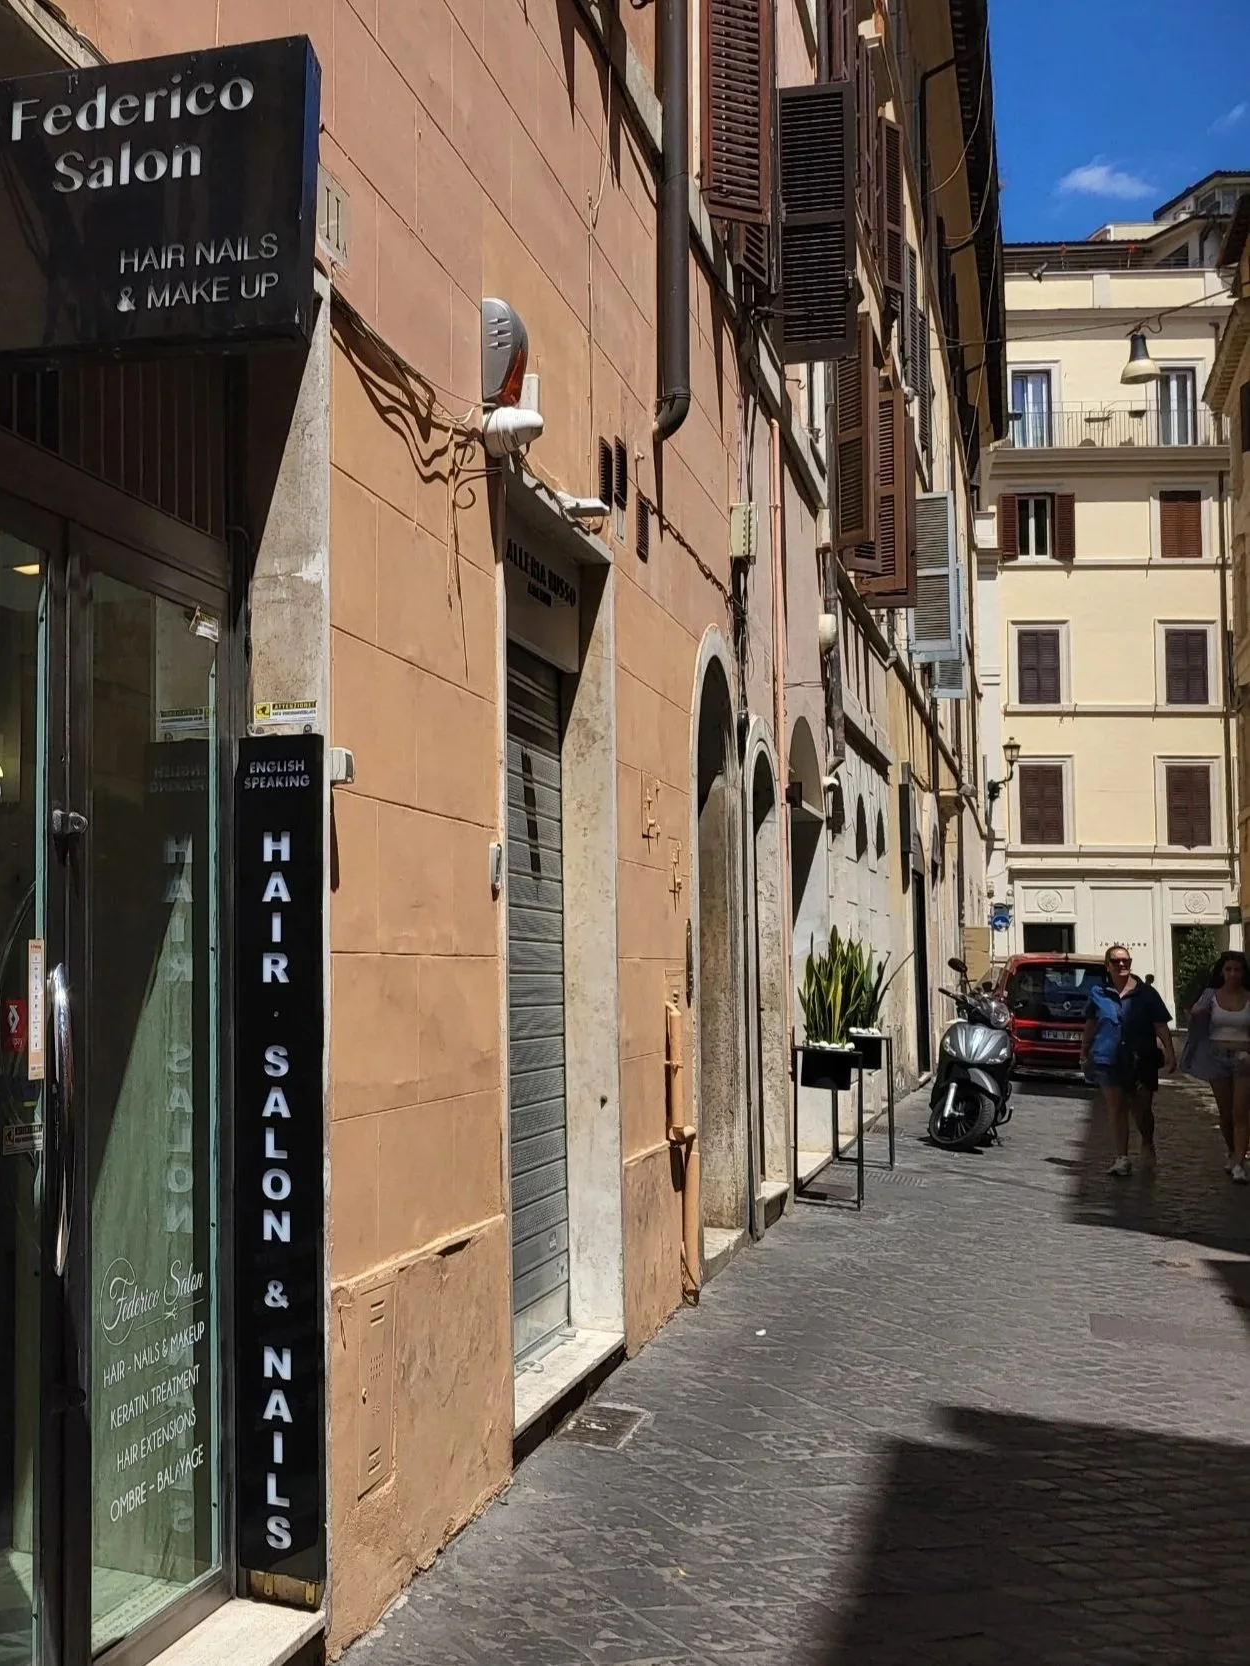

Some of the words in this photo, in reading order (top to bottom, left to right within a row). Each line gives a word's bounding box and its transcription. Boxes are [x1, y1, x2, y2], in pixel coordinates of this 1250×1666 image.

[11, 73, 255, 141] Federico
[52, 141, 203, 193] Salon
[119, 243, 185, 275] HAIR
[195, 232, 279, 263] NAILS
[116, 286, 136, 312] &
[147, 276, 230, 309] MAKE
[240, 273, 279, 300] UP
[506, 538, 547, 587] ALLERIA
[244, 775, 310, 789] SPEAKING
[250, 760, 305, 774] ENGLISH
[262, 832, 291, 983] HAIR
[262, 1044, 291, 1242] SALON
[102, 1276, 161, 1330] Federico
[163, 1260, 204, 1305] Salon
[264, 1280, 289, 1309] &
[103, 1360, 125, 1388] HAIR
[134, 1342, 160, 1372] NAILS
[171, 1321, 205, 1353] MAKEUP
[110, 1392, 149, 1430] KERATIN
[151, 1364, 200, 1407] TREATMENT
[117, 1443, 138, 1472] HAIR
[140, 1407, 197, 1458] EXTENSIONS
[263, 1346, 293, 1550] NAILS
[110, 1481, 147, 1522] OMBRE
[157, 1444, 204, 1493] BALAYAGE
